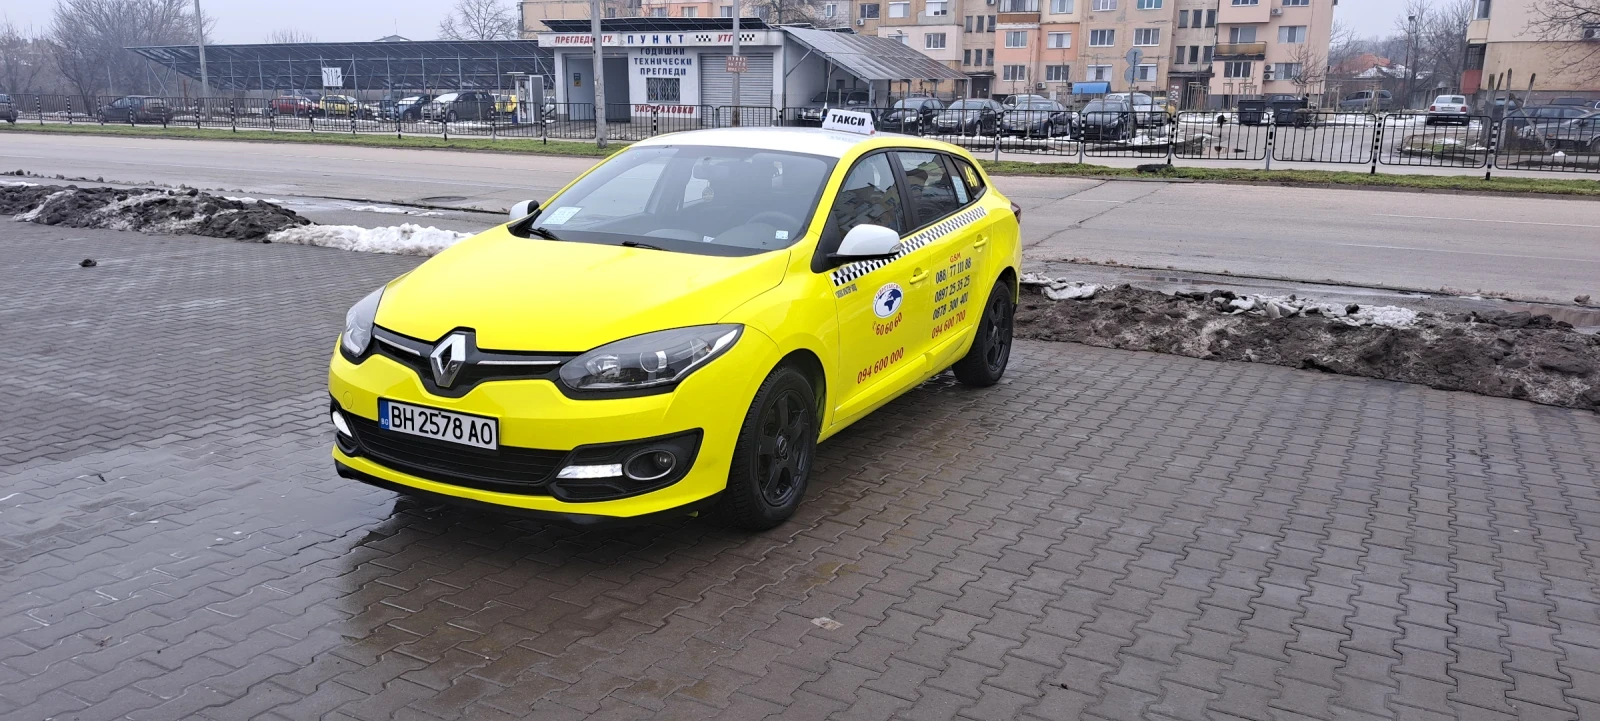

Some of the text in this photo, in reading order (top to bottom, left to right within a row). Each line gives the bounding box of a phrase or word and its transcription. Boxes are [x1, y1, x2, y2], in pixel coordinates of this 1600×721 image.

[627, 34, 684, 44] ПУНКТ
[640, 48, 685, 56] ГОДИШНИ
[640, 68, 687, 76] ПРЕГЛЕДИ
[634, 104, 695, 114] ЗАСТРАХОВКИ
[832, 114, 866, 127] ТАКСИ
[963, 166, 978, 188] 46
[949, 252, 961, 263] GSM
[949, 264, 957, 277] 77
[965, 257, 972, 270] 88
[949, 282, 956, 296] 25
[964, 274, 971, 288] 25
[876, 312, 902, 336] 60 60 60
[931, 309, 966, 339] 094 600 700
[857, 346, 904, 385] 094 600 000
[381, 418, 389, 426] BG
[391, 405, 493, 445] BH 2578 AO
